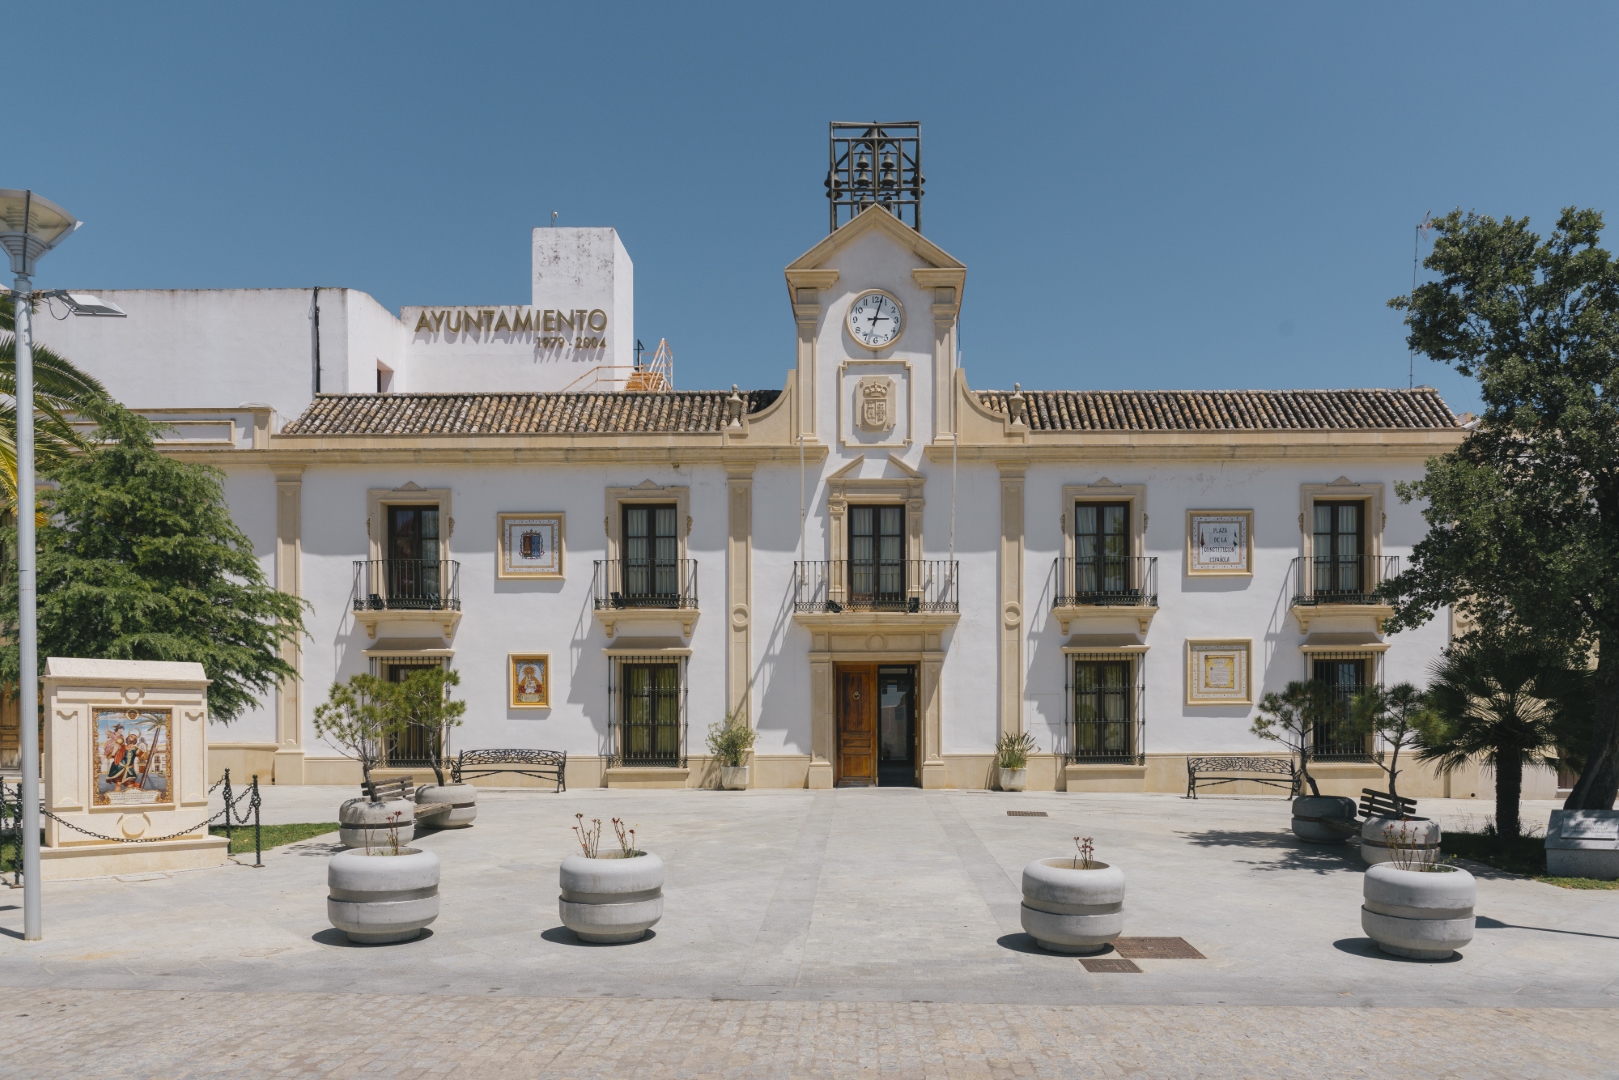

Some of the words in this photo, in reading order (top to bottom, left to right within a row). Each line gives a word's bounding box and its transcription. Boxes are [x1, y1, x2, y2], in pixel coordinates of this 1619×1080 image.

[863, 298, 868, 306] 11
[872, 296, 880, 304] 12
[890, 306, 896, 314] 2
[414, 308, 608, 333] AYUNTAMIENTO
[852, 316, 858, 324] 9
[893, 316, 899, 324] 3
[855, 326, 861, 334] 8
[862, 333, 868, 341] 7
[884, 334, 889, 342] 5
[536, 336, 565, 349] 1979
[575, 336, 607, 349] 2004
